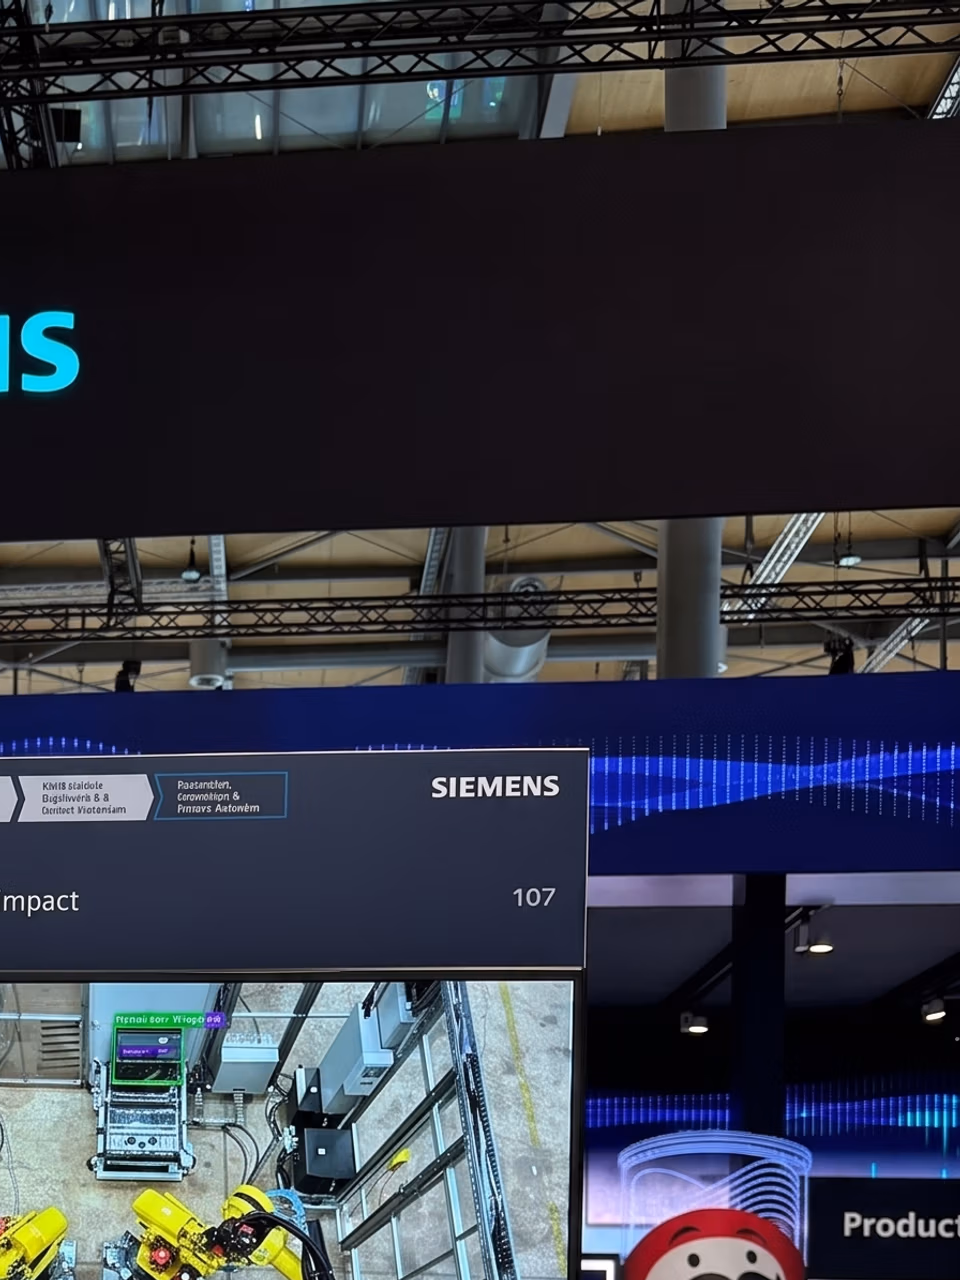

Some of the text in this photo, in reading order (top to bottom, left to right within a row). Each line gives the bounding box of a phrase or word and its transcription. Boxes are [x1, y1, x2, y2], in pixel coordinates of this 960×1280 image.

[431, 775, 560, 798] SIEMENS
[512, 887, 556, 907] 107
[843, 1211, 960, 1239] Product
